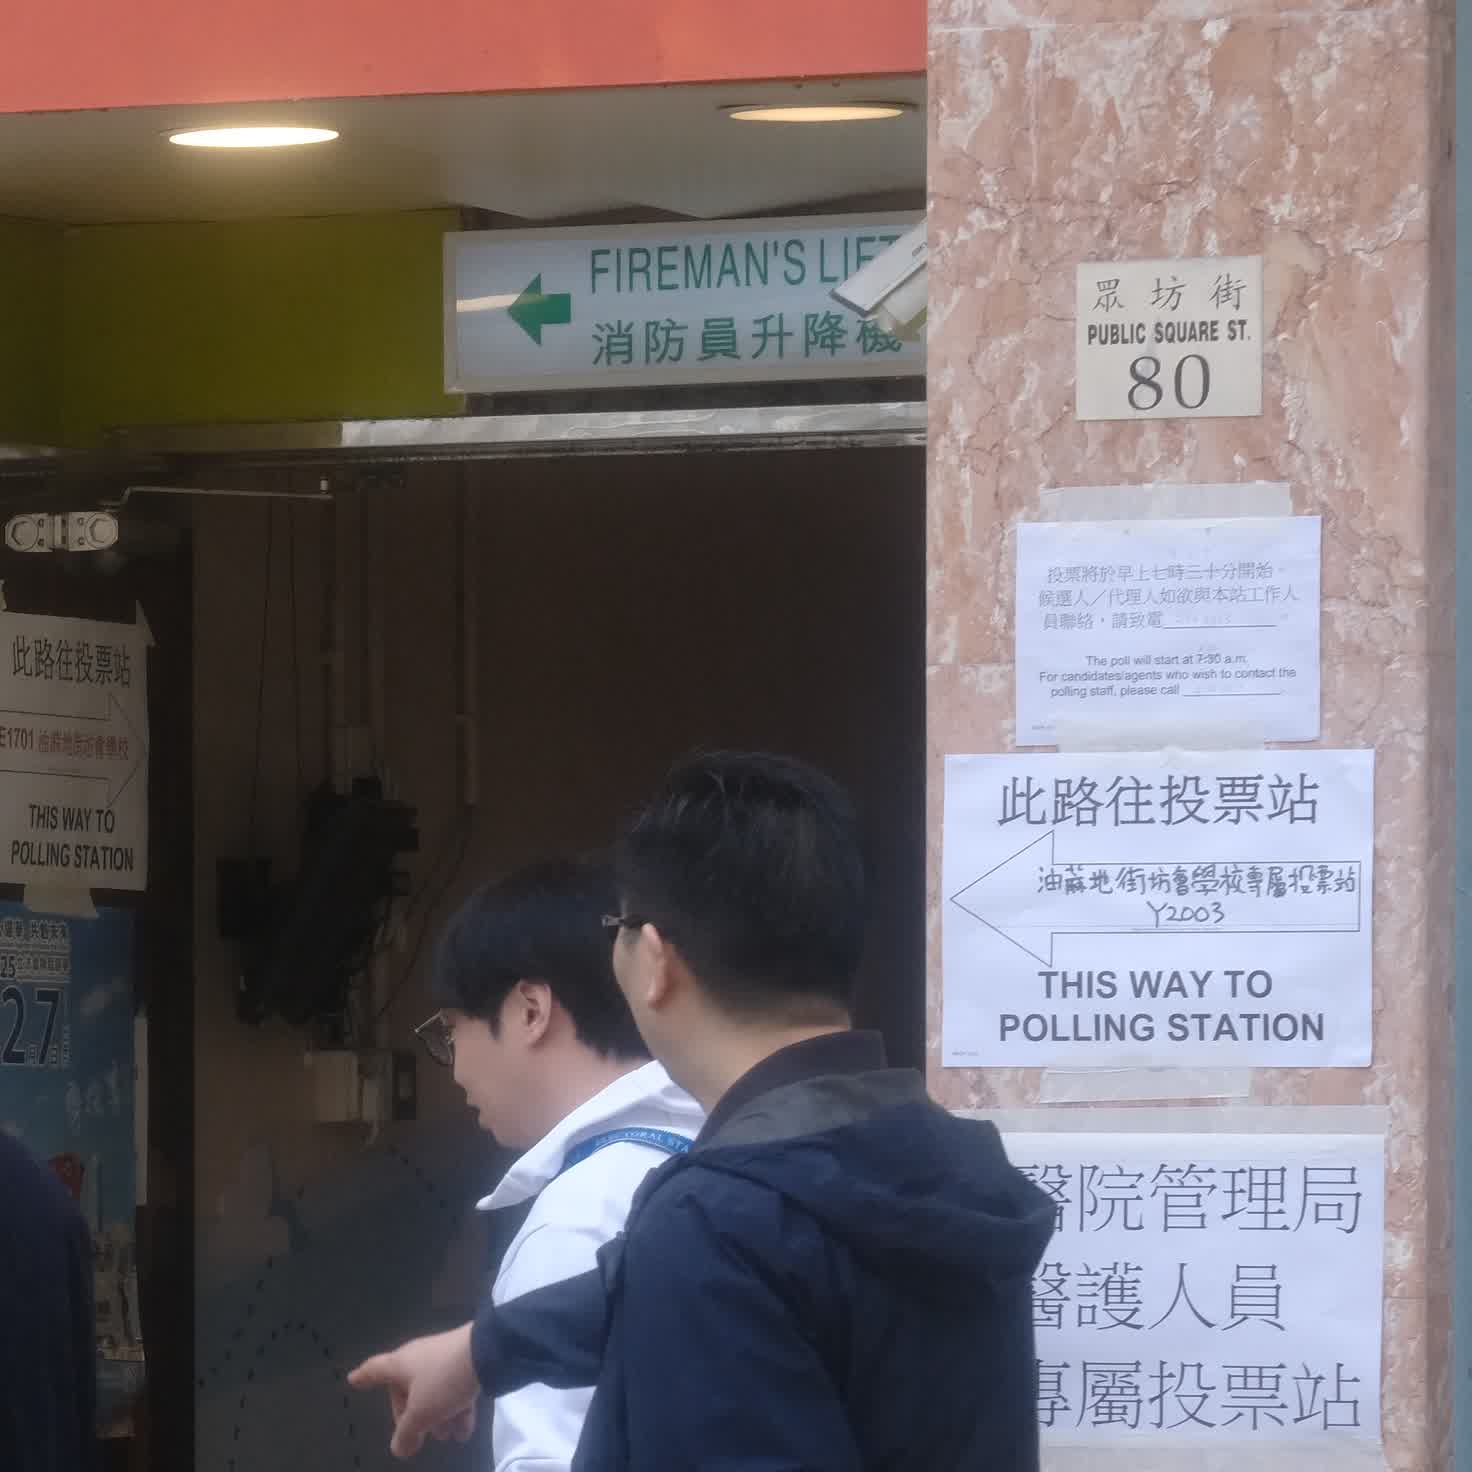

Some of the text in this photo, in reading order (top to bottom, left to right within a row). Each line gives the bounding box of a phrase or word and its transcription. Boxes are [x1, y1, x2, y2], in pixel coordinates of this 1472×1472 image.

[589, 233, 904, 295] FIREMAN'S LIF
[1088, 319, 1252, 346] PUBLIC SQUARE ST.
[1127, 354, 1211, 411] 80
[11, 634, 132, 688] 此路往投票站
[1039, 671, 1058, 683] For
[1165, 670, 1189, 681] who
[1192, 668, 1217, 680] wish
[1220, 669, 1233, 680] to
[1235, 667, 1277, 680] contact
[1278, 667, 1297, 678] the
[1085, 655, 1108, 667] The
[1109, 654, 1131, 668] poll
[1133, 655, 1152, 666] will
[1154, 654, 1180, 666] start
[1181, 655, 1194, 665] at
[1050, 684, 1088, 698] polling
[1119, 684, 1158, 698] please
[1160, 683, 1181, 696] call
[997, 772, 1320, 828] 此路往投票站
[29, 804, 115, 834] THIS WAY TO
[11, 839, 134, 872] POLLING STATION
[1146, 901, 1226, 929] Y2003
[1037, 970, 1274, 999] THIS WAY TO
[999, 1012, 1325, 1043] POLLING STATION
